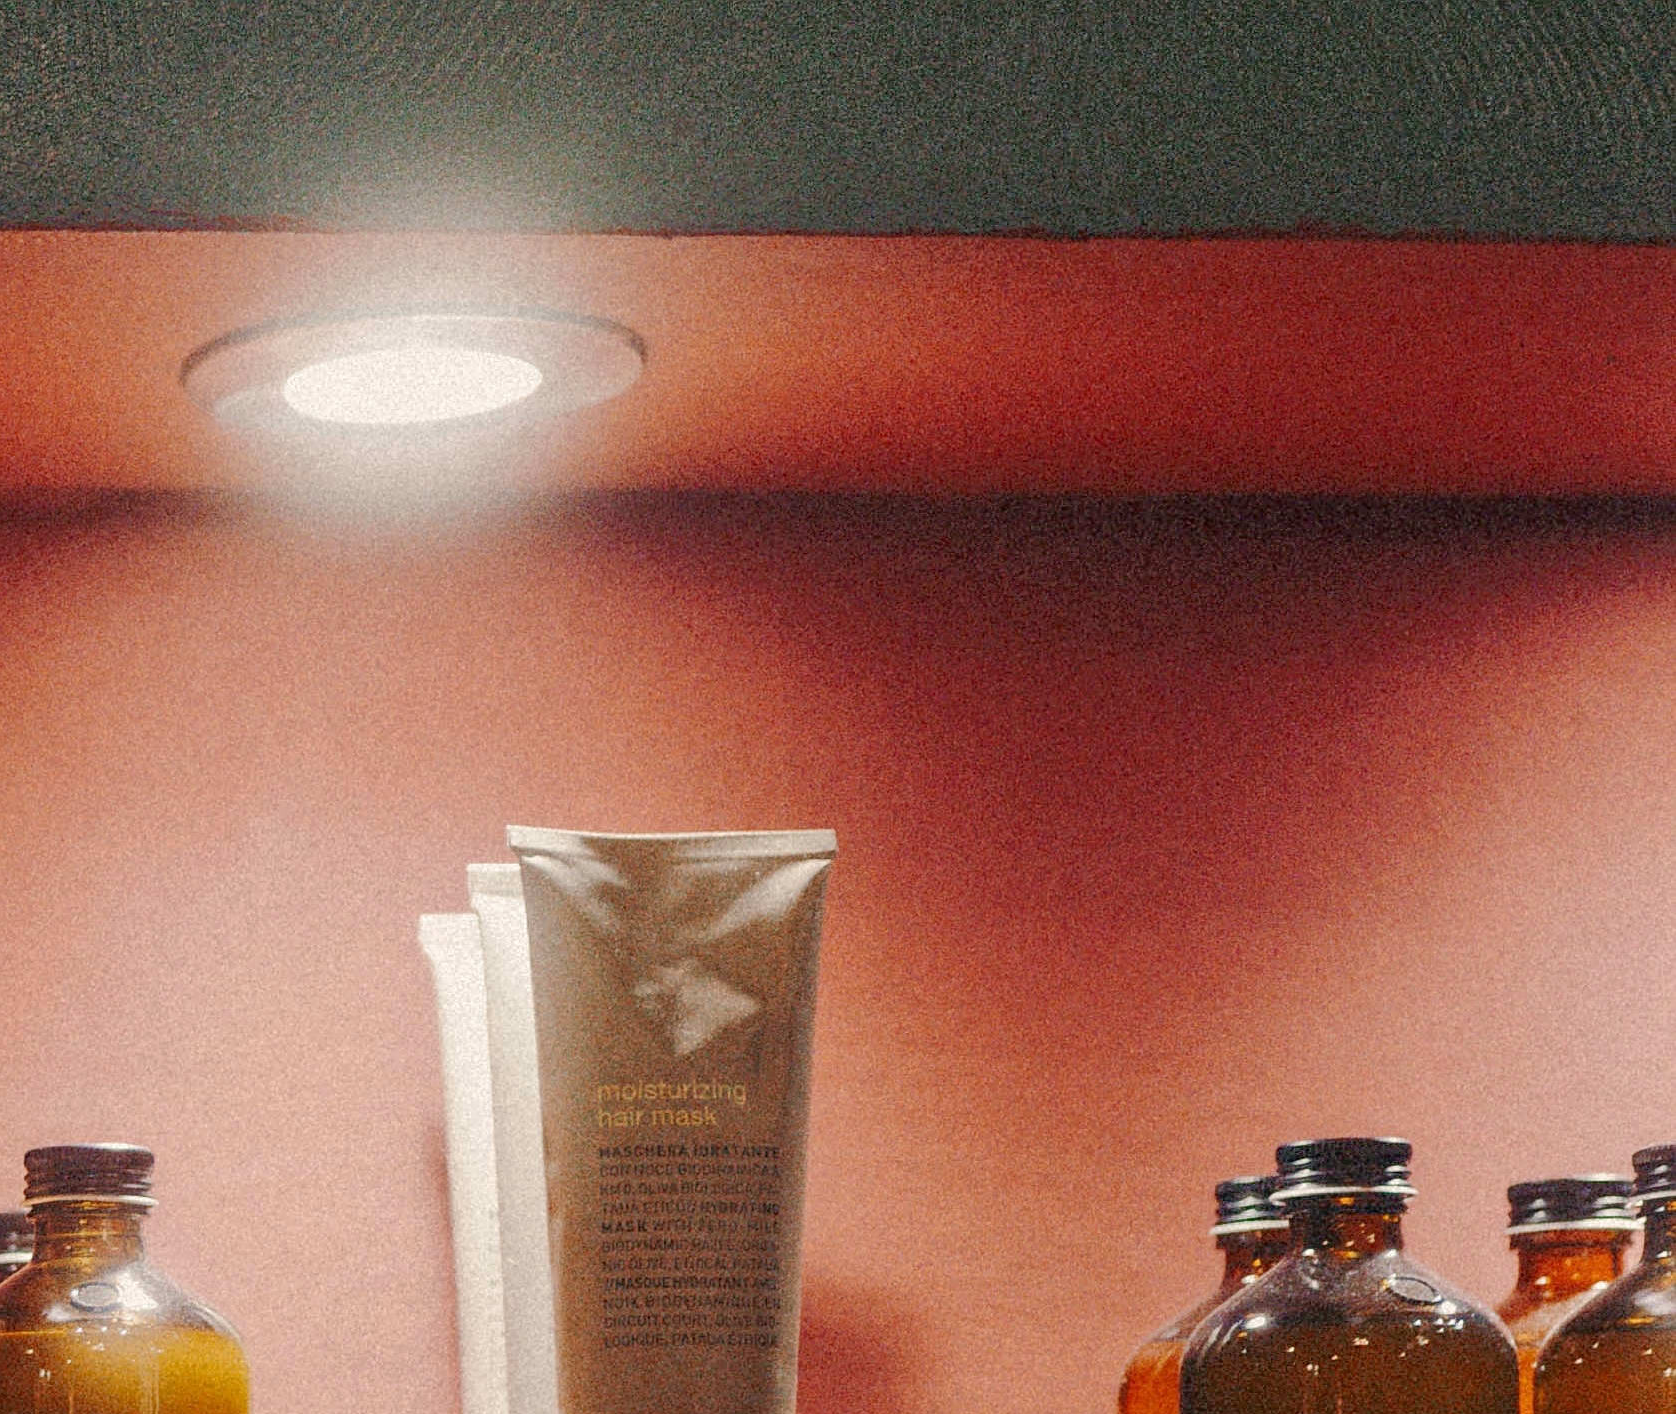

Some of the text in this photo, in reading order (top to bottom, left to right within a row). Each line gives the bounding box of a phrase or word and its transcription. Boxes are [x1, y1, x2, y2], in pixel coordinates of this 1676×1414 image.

[597, 1079, 746, 1105] moisturizing
[597, 1106, 718, 1128] hair mask
